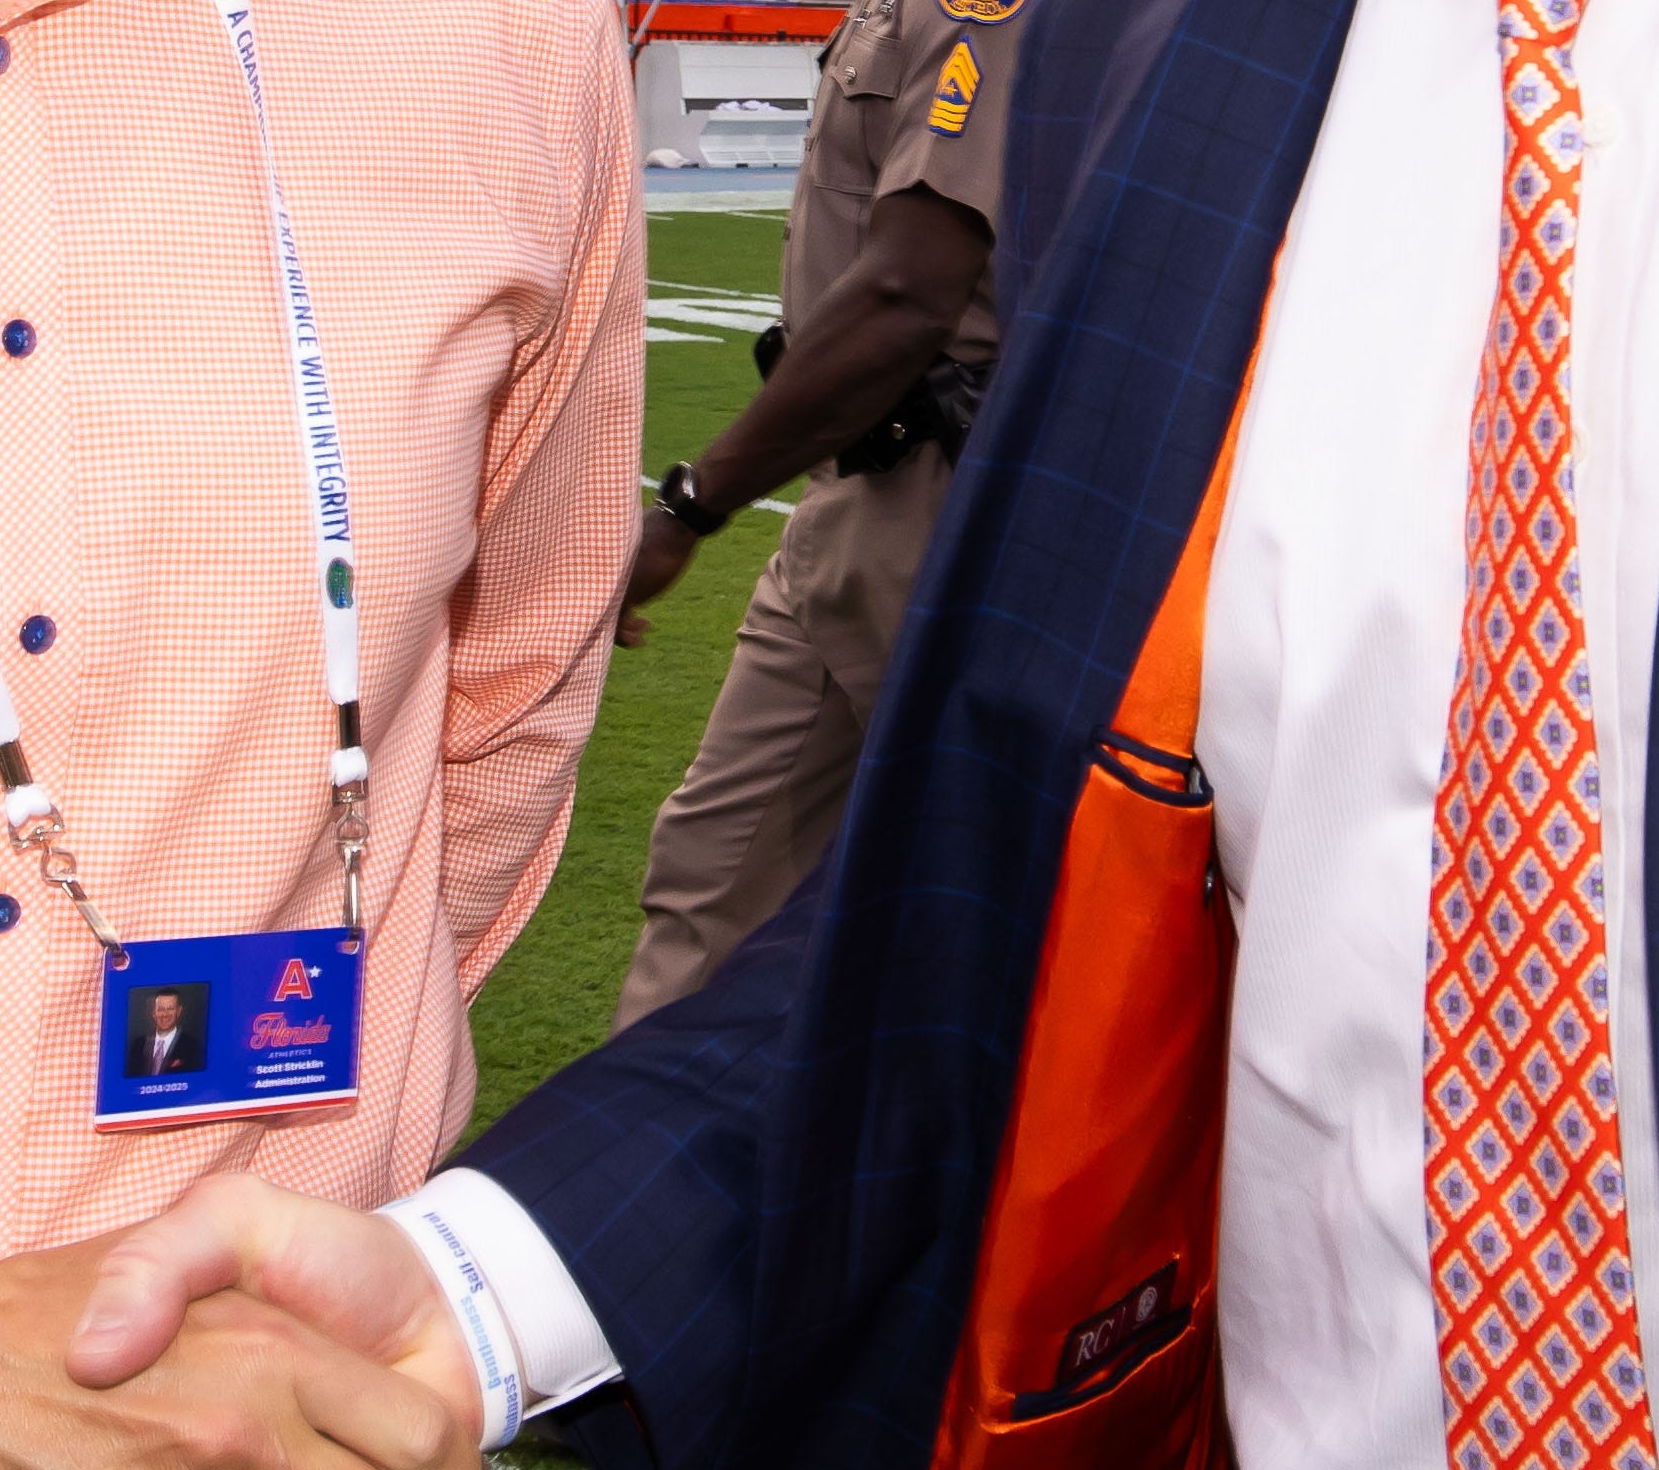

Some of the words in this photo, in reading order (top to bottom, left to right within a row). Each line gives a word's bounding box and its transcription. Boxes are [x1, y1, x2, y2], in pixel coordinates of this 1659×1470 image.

[227, 9, 249, 29] A
[278, 211, 319, 348] EXPERIENCE
[299, 356, 332, 416] WITH
[309, 425, 351, 542] INTEGRITY
[250, 1012, 332, 1050] Florida
[254, 1074, 326, 1089] Administration
[256, 1063, 282, 1075] Scott
[284, 1059, 324, 1072] Stricklin
